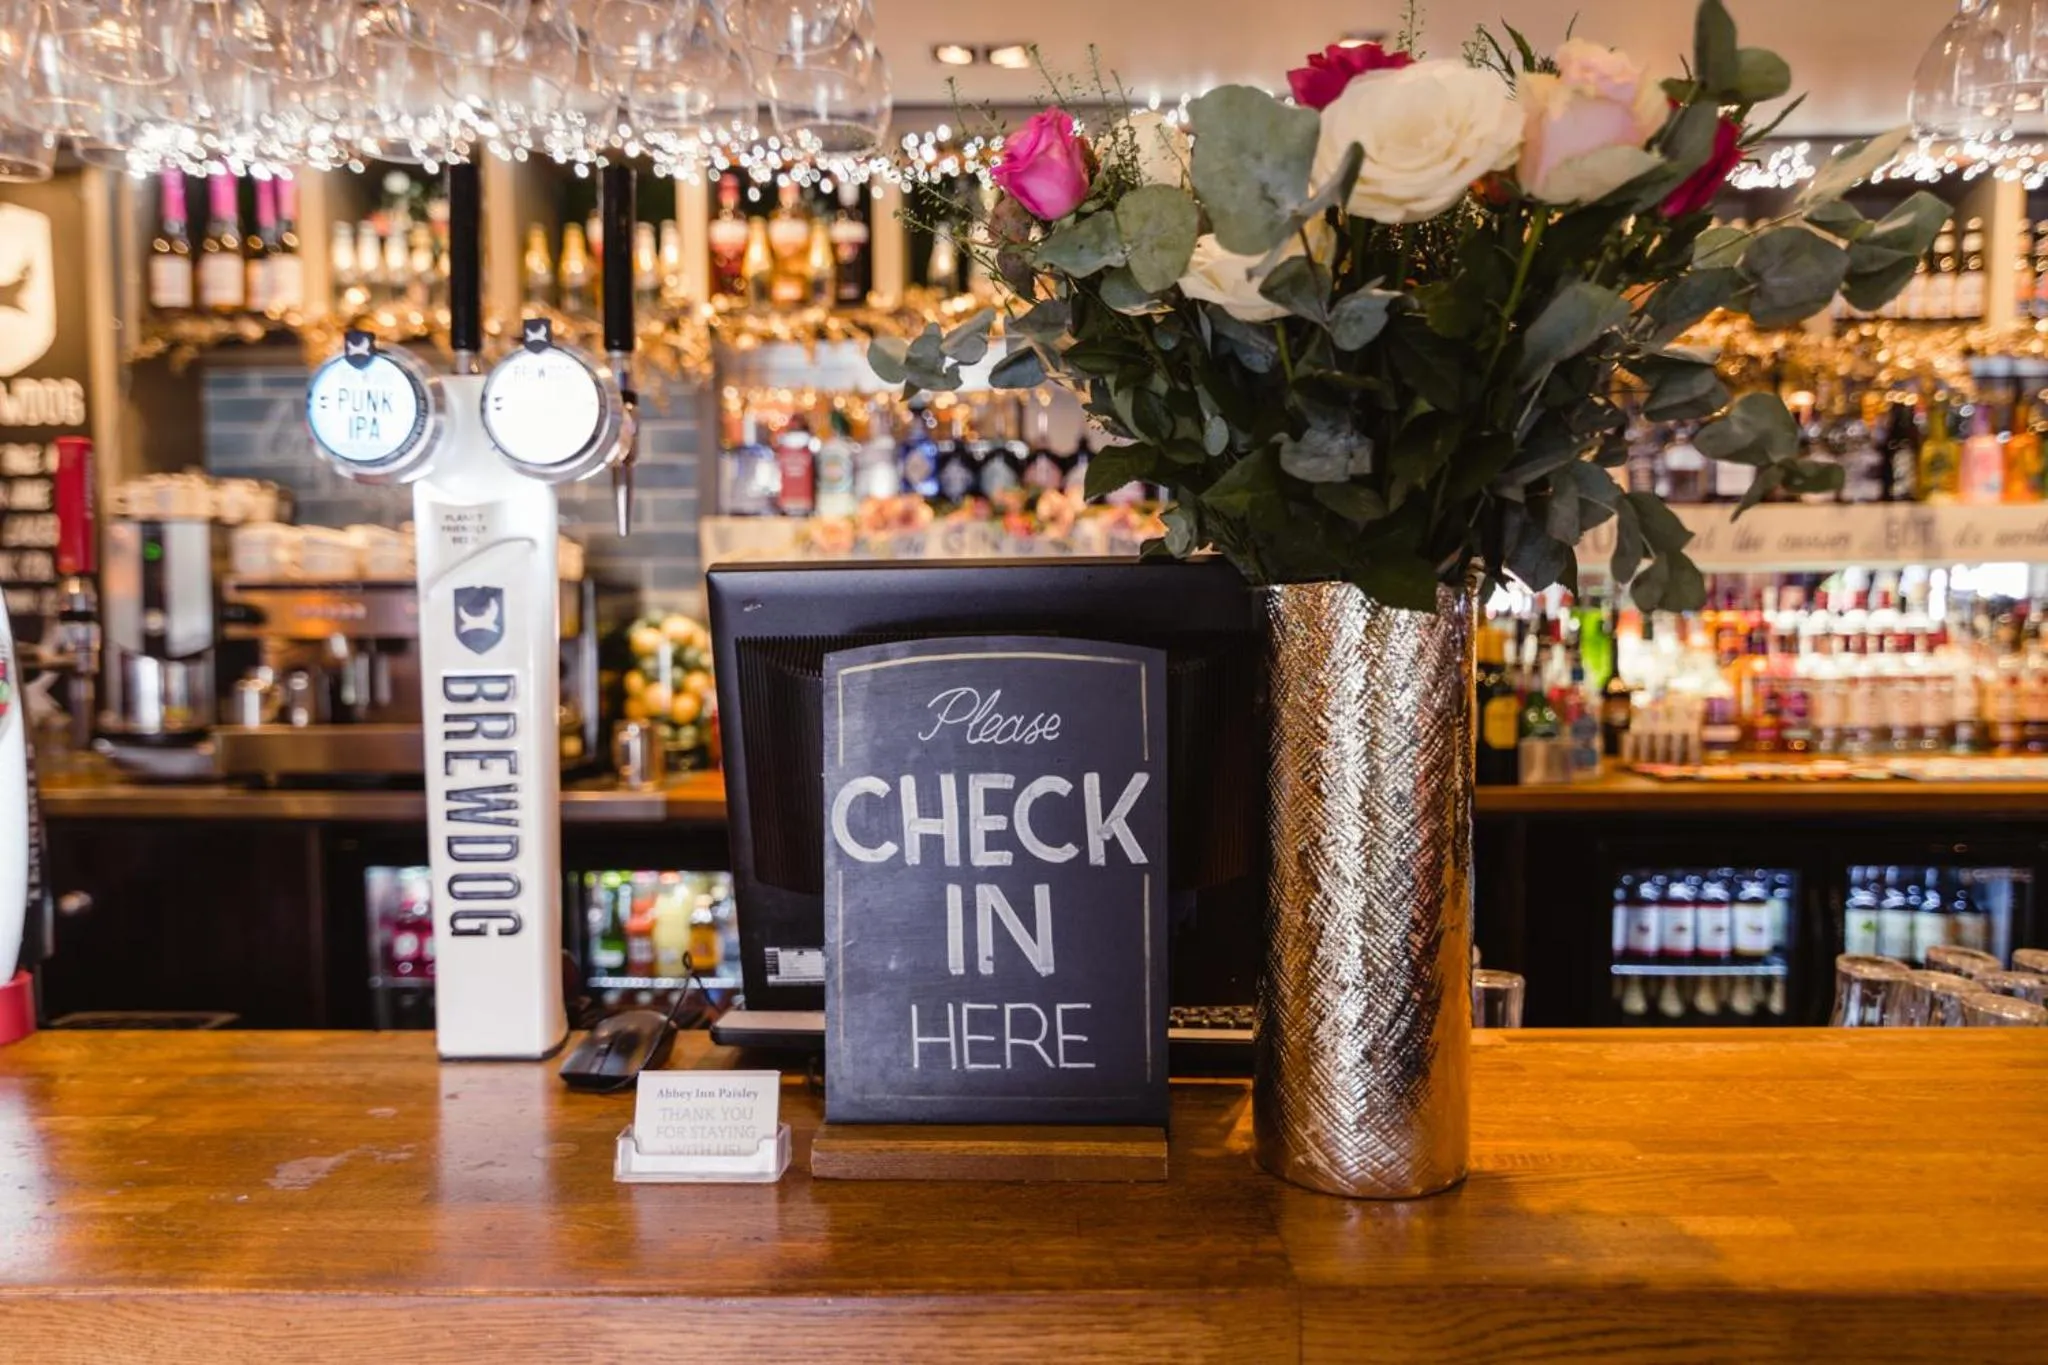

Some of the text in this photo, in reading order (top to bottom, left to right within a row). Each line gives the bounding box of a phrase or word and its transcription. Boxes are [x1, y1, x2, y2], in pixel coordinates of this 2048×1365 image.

[338, 387, 393, 413] PUNK
[349, 415, 381, 440] IPA
[918, 687, 1061, 745] Please
[443, 674, 522, 937] BREWDOG
[831, 772, 1150, 867] CHECK
[946, 883, 1055, 977] IN
[911, 1003, 1096, 1070] HERE
[656, 1087, 759, 1100] Abbey Inn Paisley
[659, 1107, 754, 1121] THANK YOU
[656, 1125, 757, 1140] FOR STAYING
